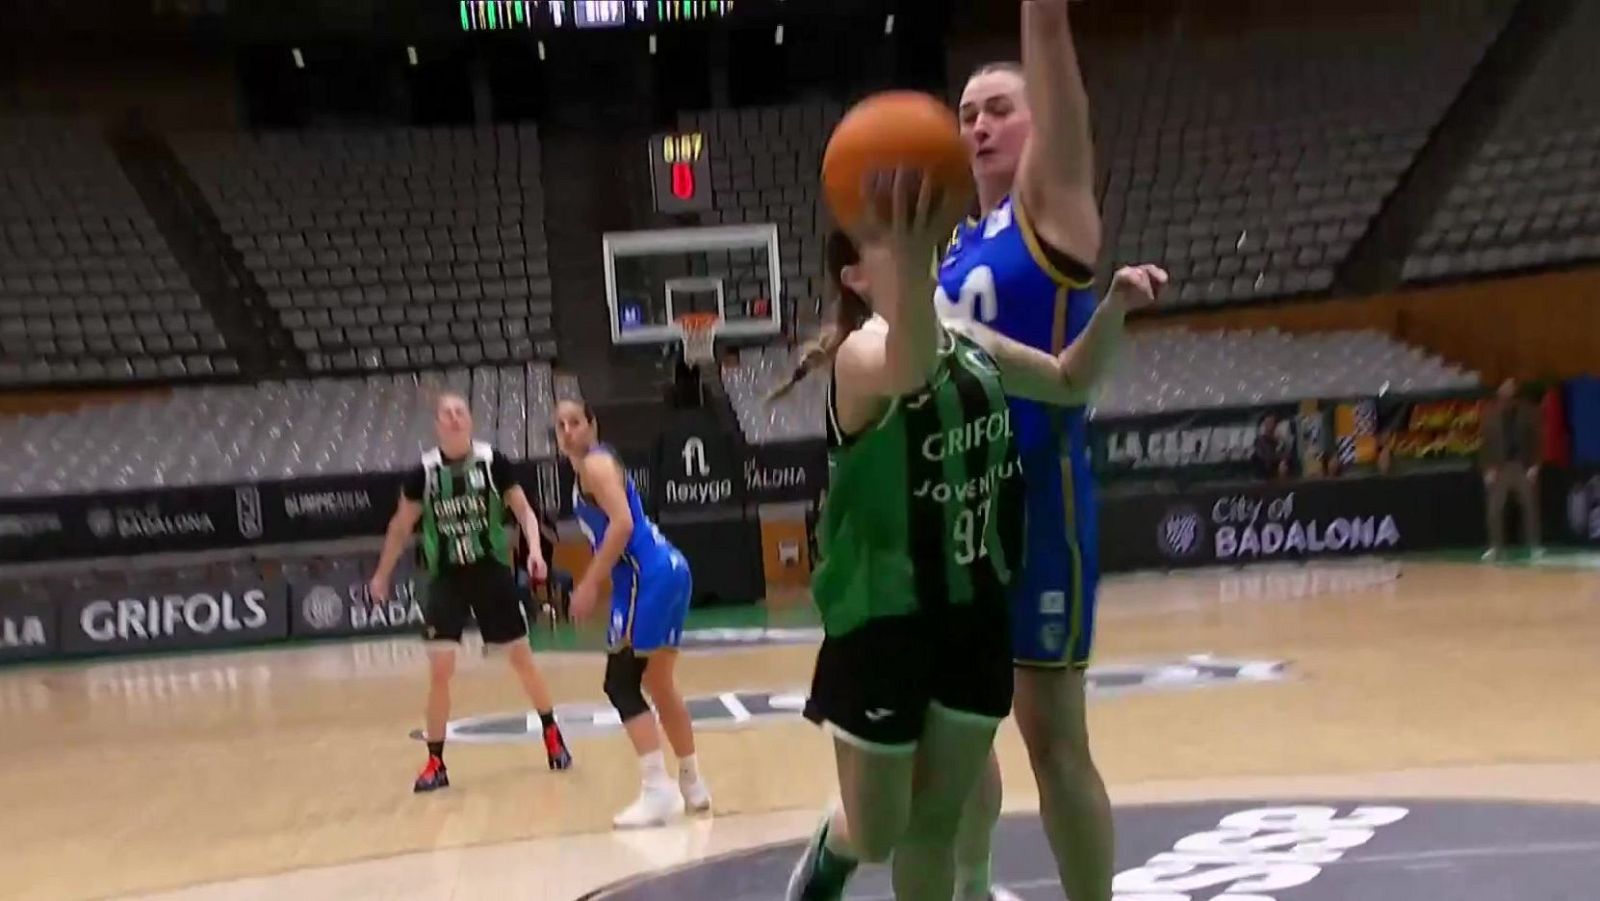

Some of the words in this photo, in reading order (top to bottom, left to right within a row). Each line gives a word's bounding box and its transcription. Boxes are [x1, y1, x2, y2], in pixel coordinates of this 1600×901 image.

[921, 408, 1013, 461] GRIFOL
[1214, 513, 1400, 558] BADALONA
[0, 616, 46, 648] LA
[79, 589, 267, 642] GRIFOLS
[350, 598, 425, 630] BADA
